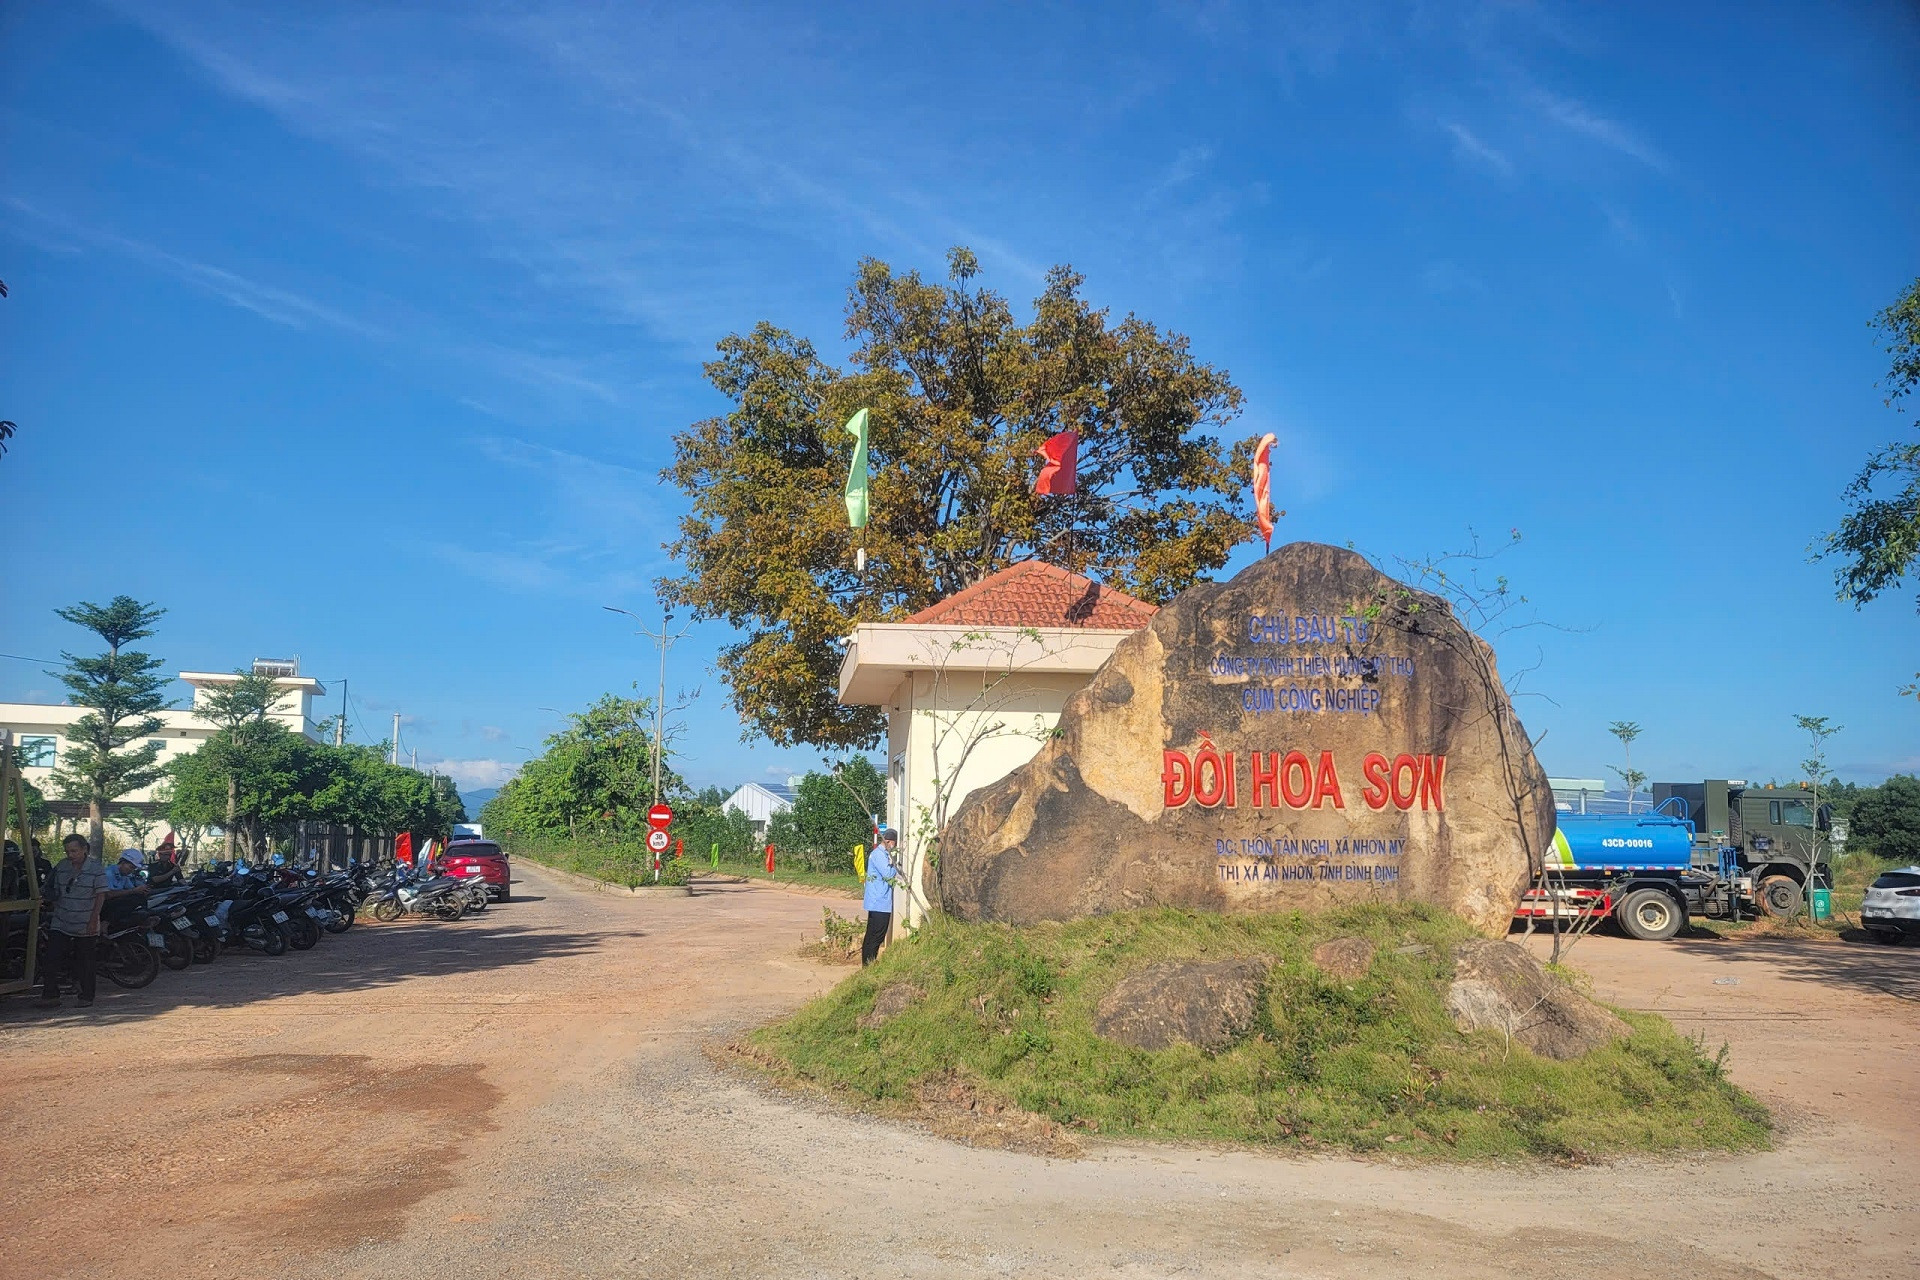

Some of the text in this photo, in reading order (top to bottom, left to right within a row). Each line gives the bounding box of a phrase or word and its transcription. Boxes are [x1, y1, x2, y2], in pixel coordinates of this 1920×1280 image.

[1249, 609, 1289, 645] CHỦ
[1294, 606, 1336, 644] ĐẦU
[1210, 653, 1244, 675] CÔNG
[1246, 657, 1261, 676] TY
[1262, 656, 1294, 676] TNHH
[1242, 682, 1381, 717] CỤM CÔNG NGHIỆP
[1161, 729, 1446, 812] ĐỒI HOA SƠN
[1240, 834, 1273, 856] THÔN
[1275, 834, 1299, 855] TÂN
[1335, 835, 1350, 855] XÃ
[1352, 838, 1386, 855] NHƠN
[1602, 838, 1653, 848] 43CD-00016
[1218, 864, 1240, 885] THỊ
[1243, 861, 1260, 881] XÃ
[1263, 864, 1279, 881] AN
[1344, 860, 1372, 881] BÌNH
[1374, 864, 1400, 886] ĐỊNH
